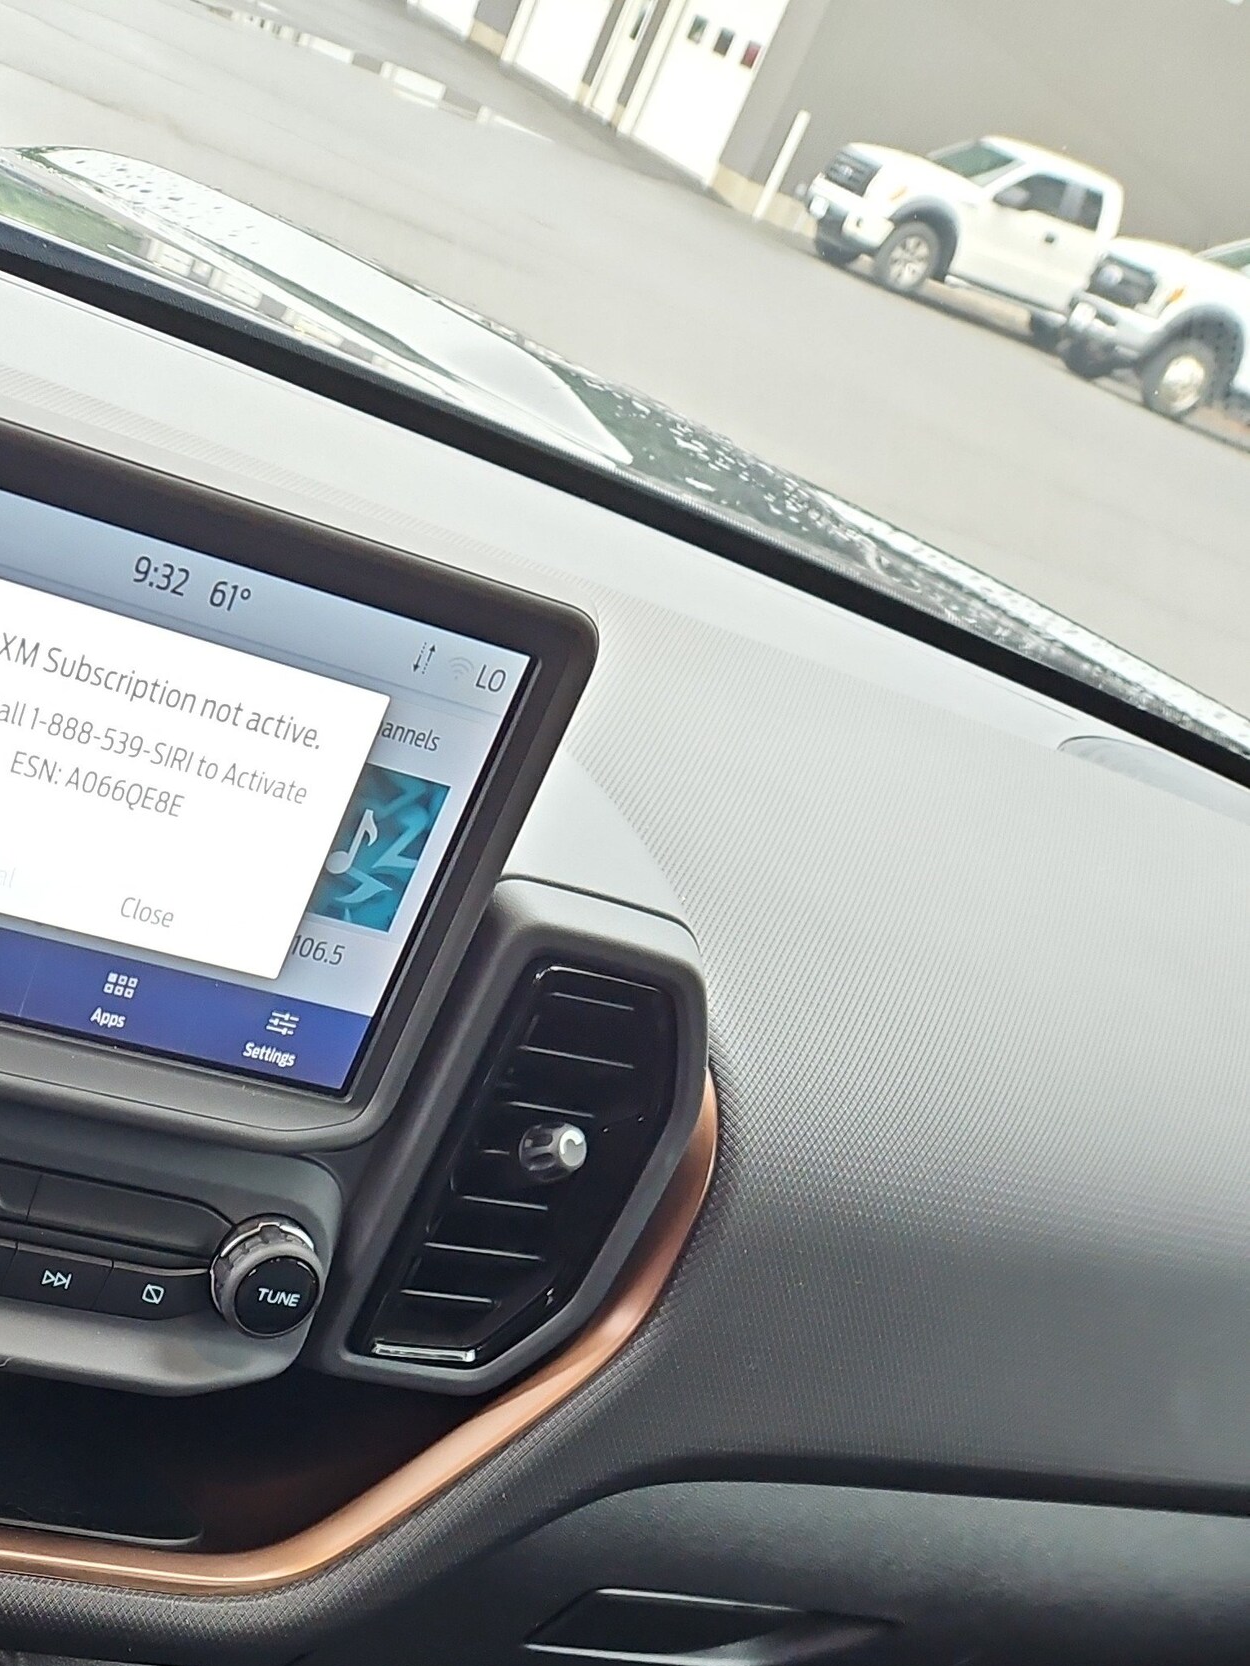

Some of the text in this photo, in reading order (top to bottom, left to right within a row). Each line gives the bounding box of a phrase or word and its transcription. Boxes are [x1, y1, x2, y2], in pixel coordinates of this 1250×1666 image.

[133, 556, 251, 611] 9:32 61°
[475, 664, 506, 693] LO
[43, 647, 196, 713] Subscription
[200, 699, 243, 727] not
[246, 712, 320, 749] active.
[31, 707, 194, 773] 1-888-539-SIRI
[197, 756, 218, 780] to
[221, 762, 307, 805] Activate
[10, 751, 185, 817] ESN: A066QE8E
[120, 896, 174, 928] Close
[291, 934, 345, 966] 106.5
[90, 1007, 126, 1028] Apps
[243, 1042, 296, 1067] Settings
[257, 1288, 300, 1307] TUNE
